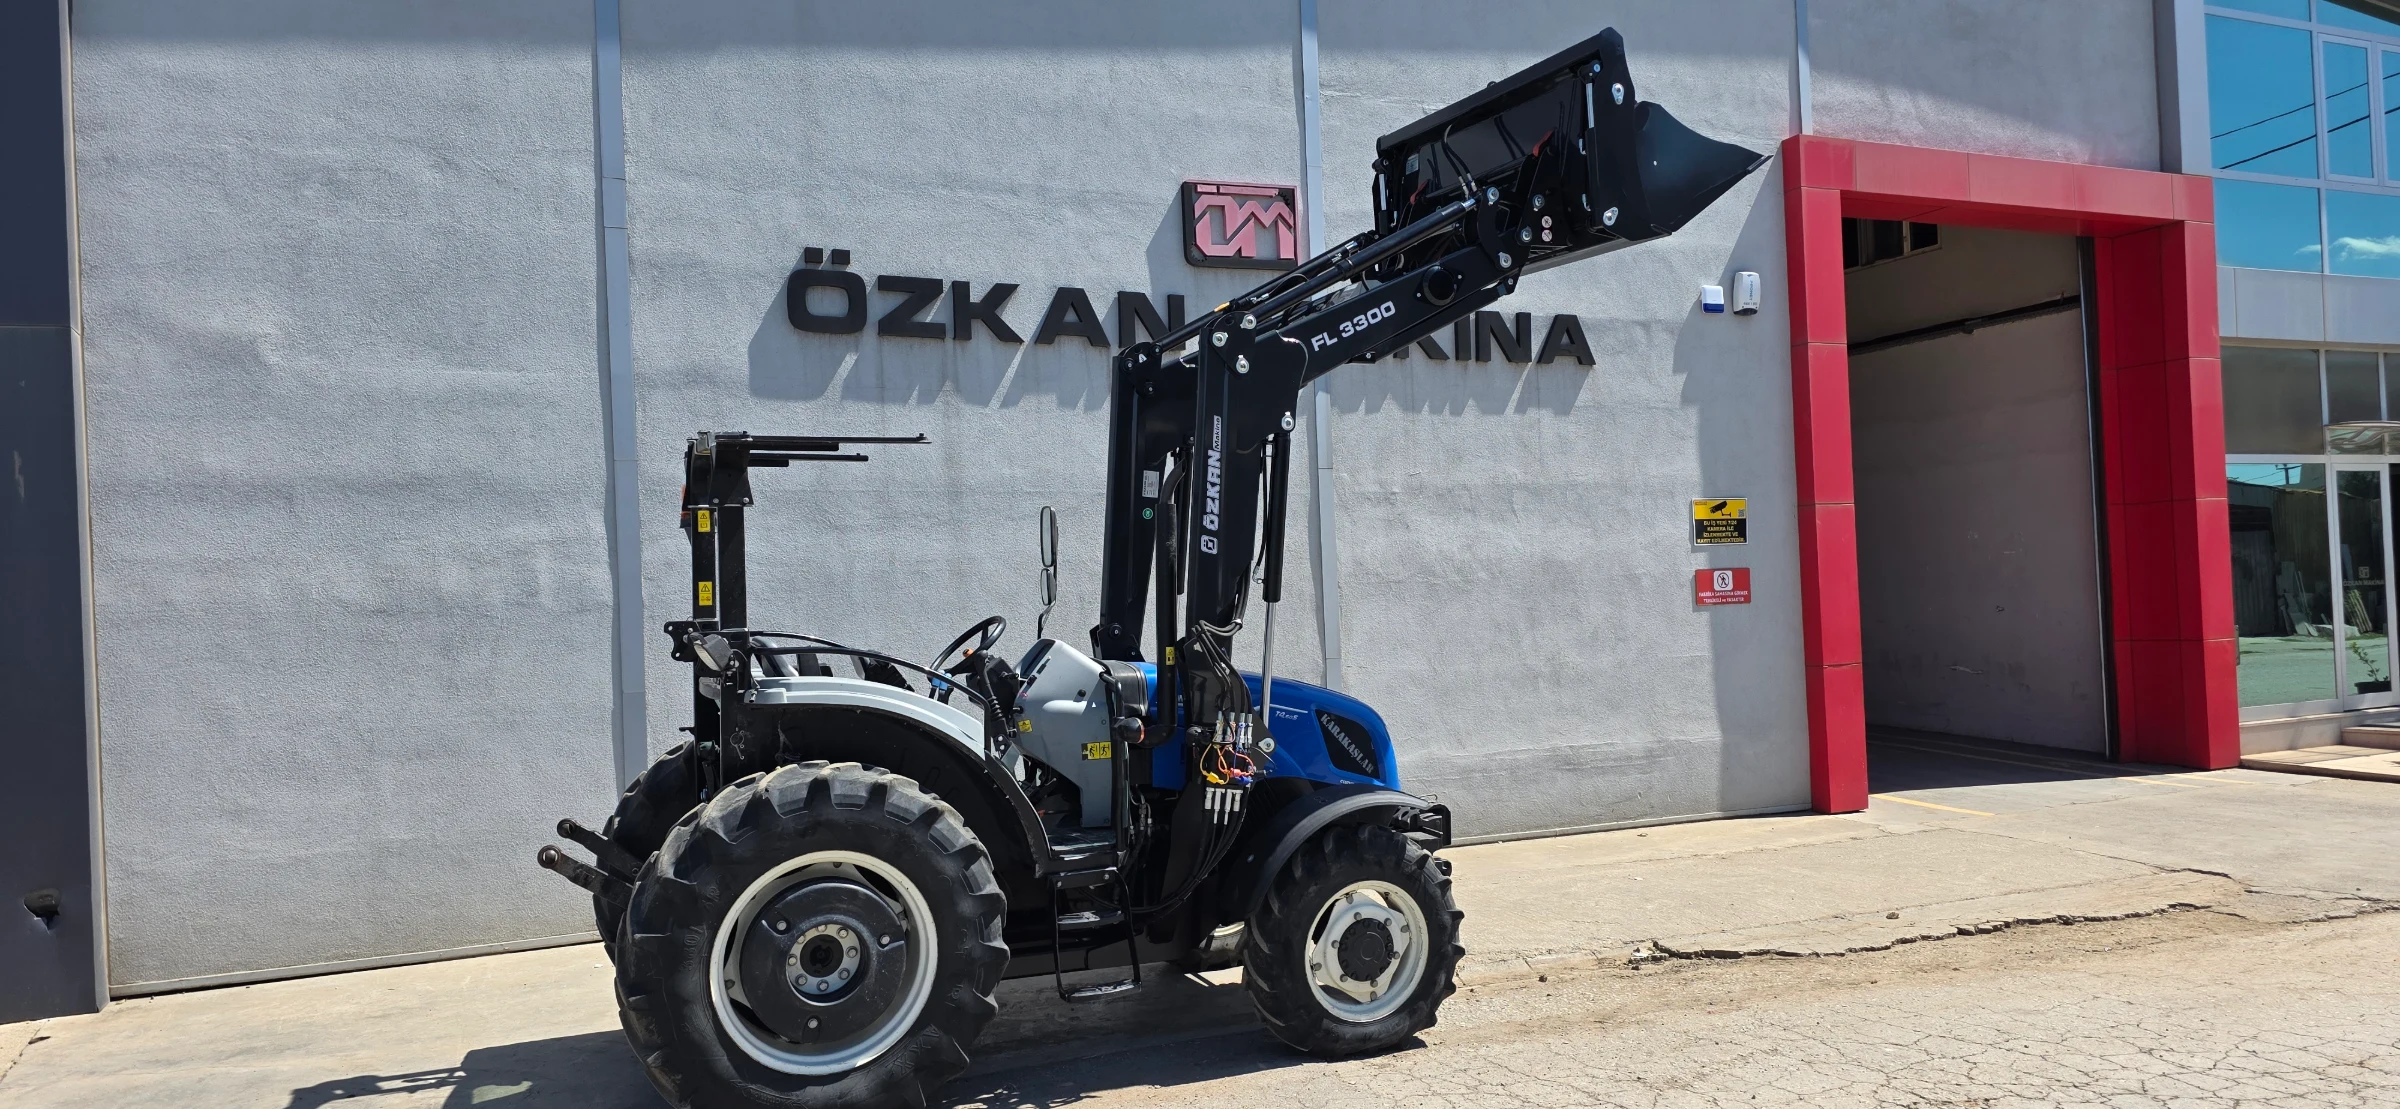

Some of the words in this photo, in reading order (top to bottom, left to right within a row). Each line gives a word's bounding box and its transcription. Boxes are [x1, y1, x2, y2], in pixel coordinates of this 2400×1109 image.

[786, 246, 1186, 350] ÖZKAN
[1310, 331, 1338, 352] FL
[1339, 300, 1396, 338] 3300
[1202, 450, 1221, 531] ÖZKAN
[1320, 713, 1375, 774] KARAKAŞLAR
